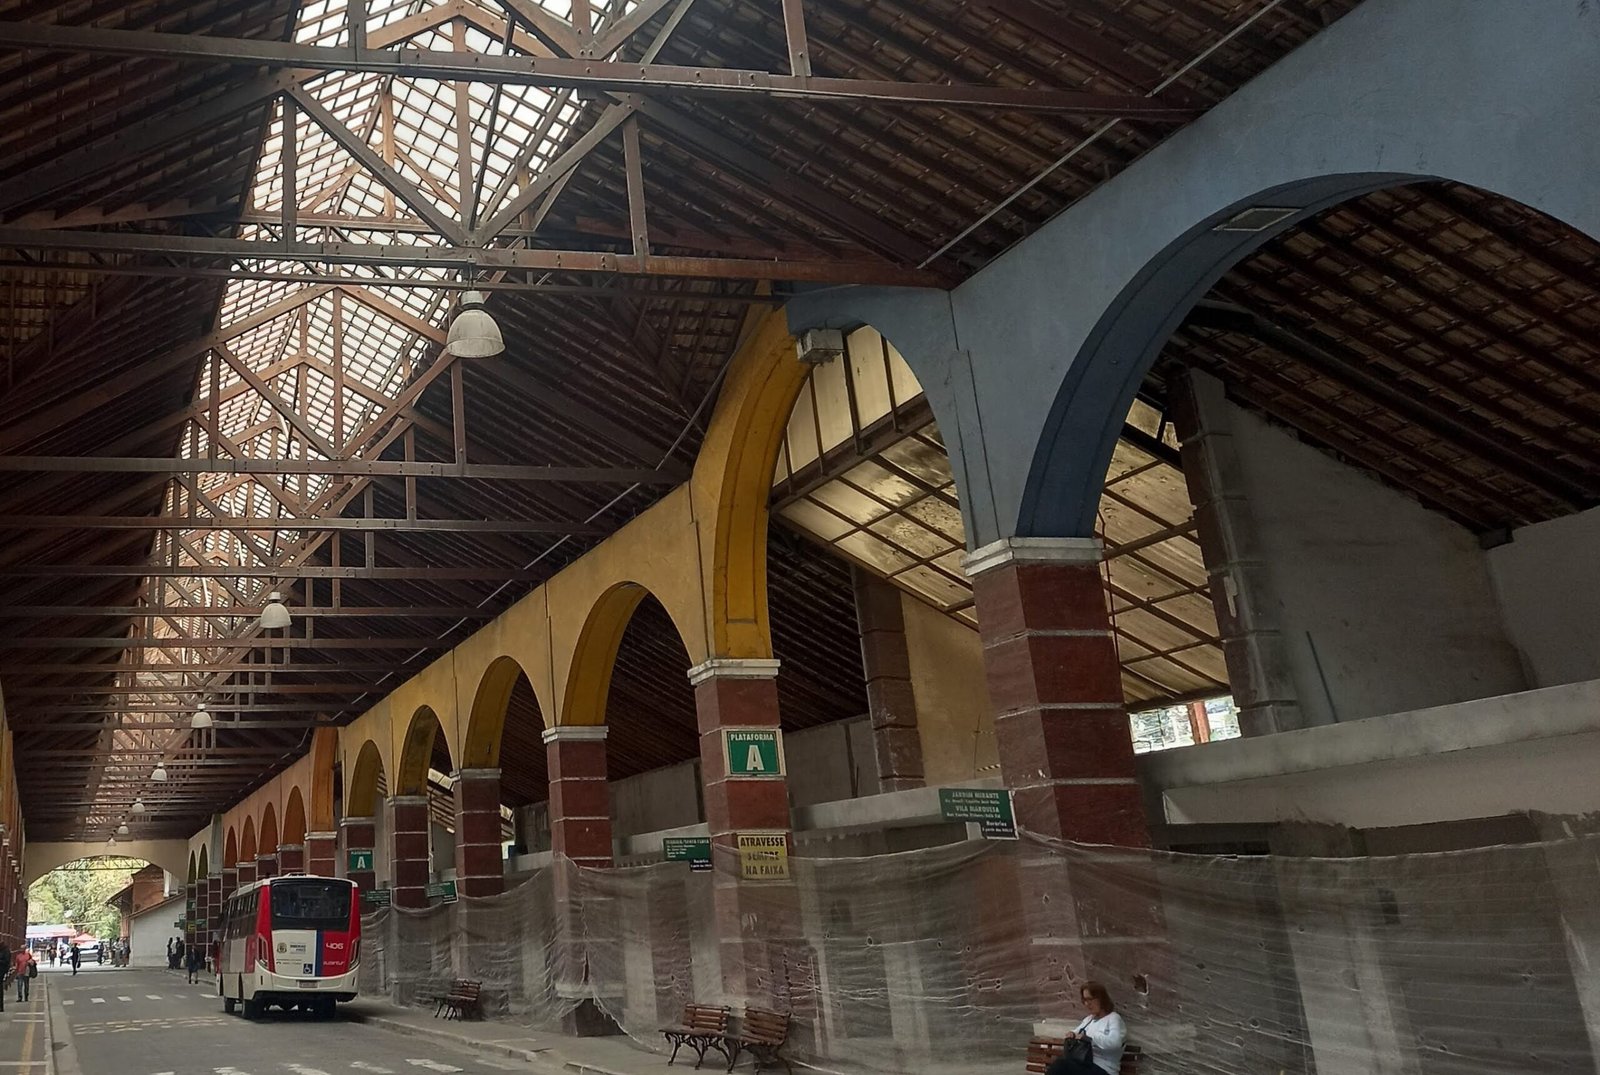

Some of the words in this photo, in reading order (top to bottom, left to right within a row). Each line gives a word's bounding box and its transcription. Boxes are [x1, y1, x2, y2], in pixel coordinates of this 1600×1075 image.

[730, 733, 774, 741] PLATAFORMA
[746, 744, 765, 771] A
[740, 837, 785, 847] ATRAVESSE
[357, 856, 366, 869] A
[745, 865, 758, 875] NA
[760, 865, 785, 875] FAIXA
[325, 942, 344, 950] 406
